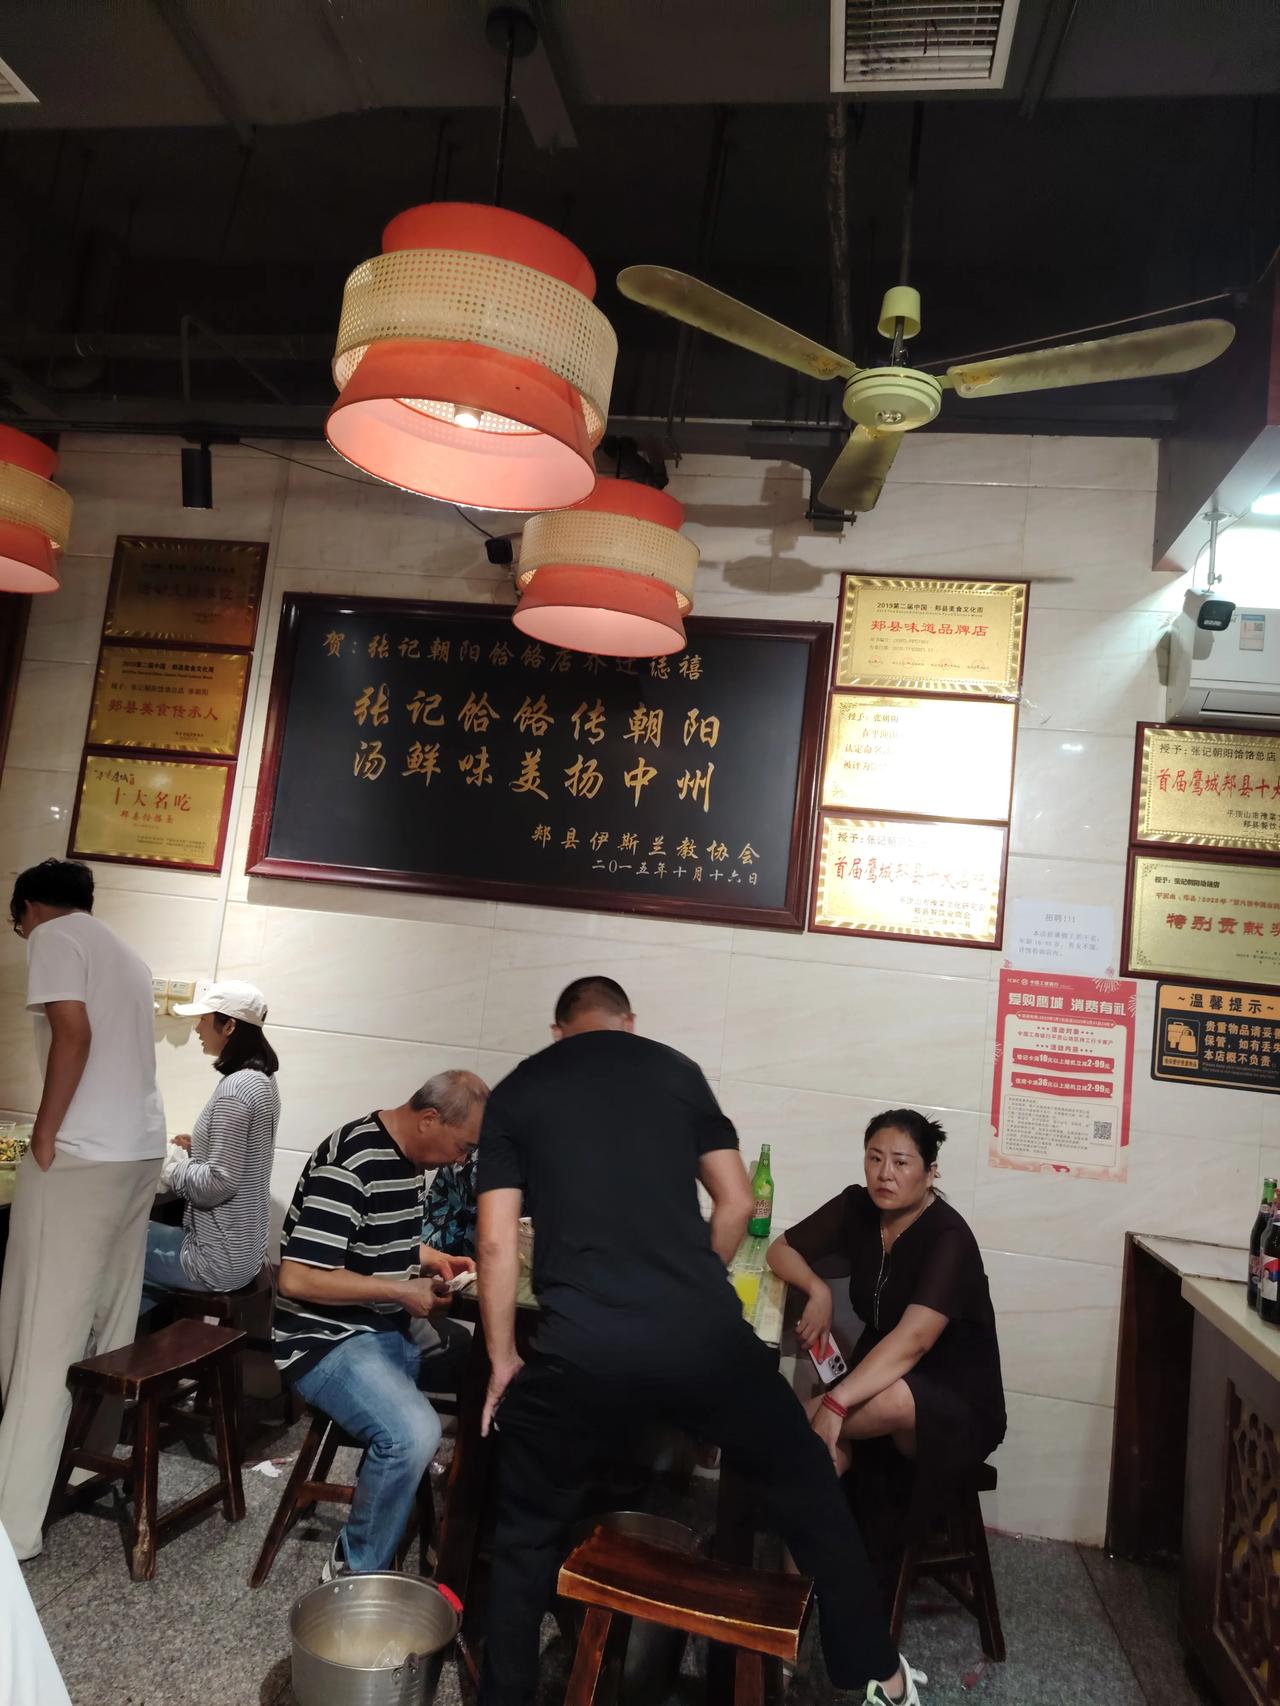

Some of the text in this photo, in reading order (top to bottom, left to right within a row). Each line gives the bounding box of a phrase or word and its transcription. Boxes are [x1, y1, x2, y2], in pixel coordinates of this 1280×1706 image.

[870, 620, 989, 637] 郏县味道品牌店
[353, 683, 720, 749] 张记饸饹传朝阳
[353, 740, 714, 812] 汤鲜味美扬中州
[531, 824, 760, 864] 郏县伊斯兰教协会
[1071, 998, 1126, 1016] 消费有礼
